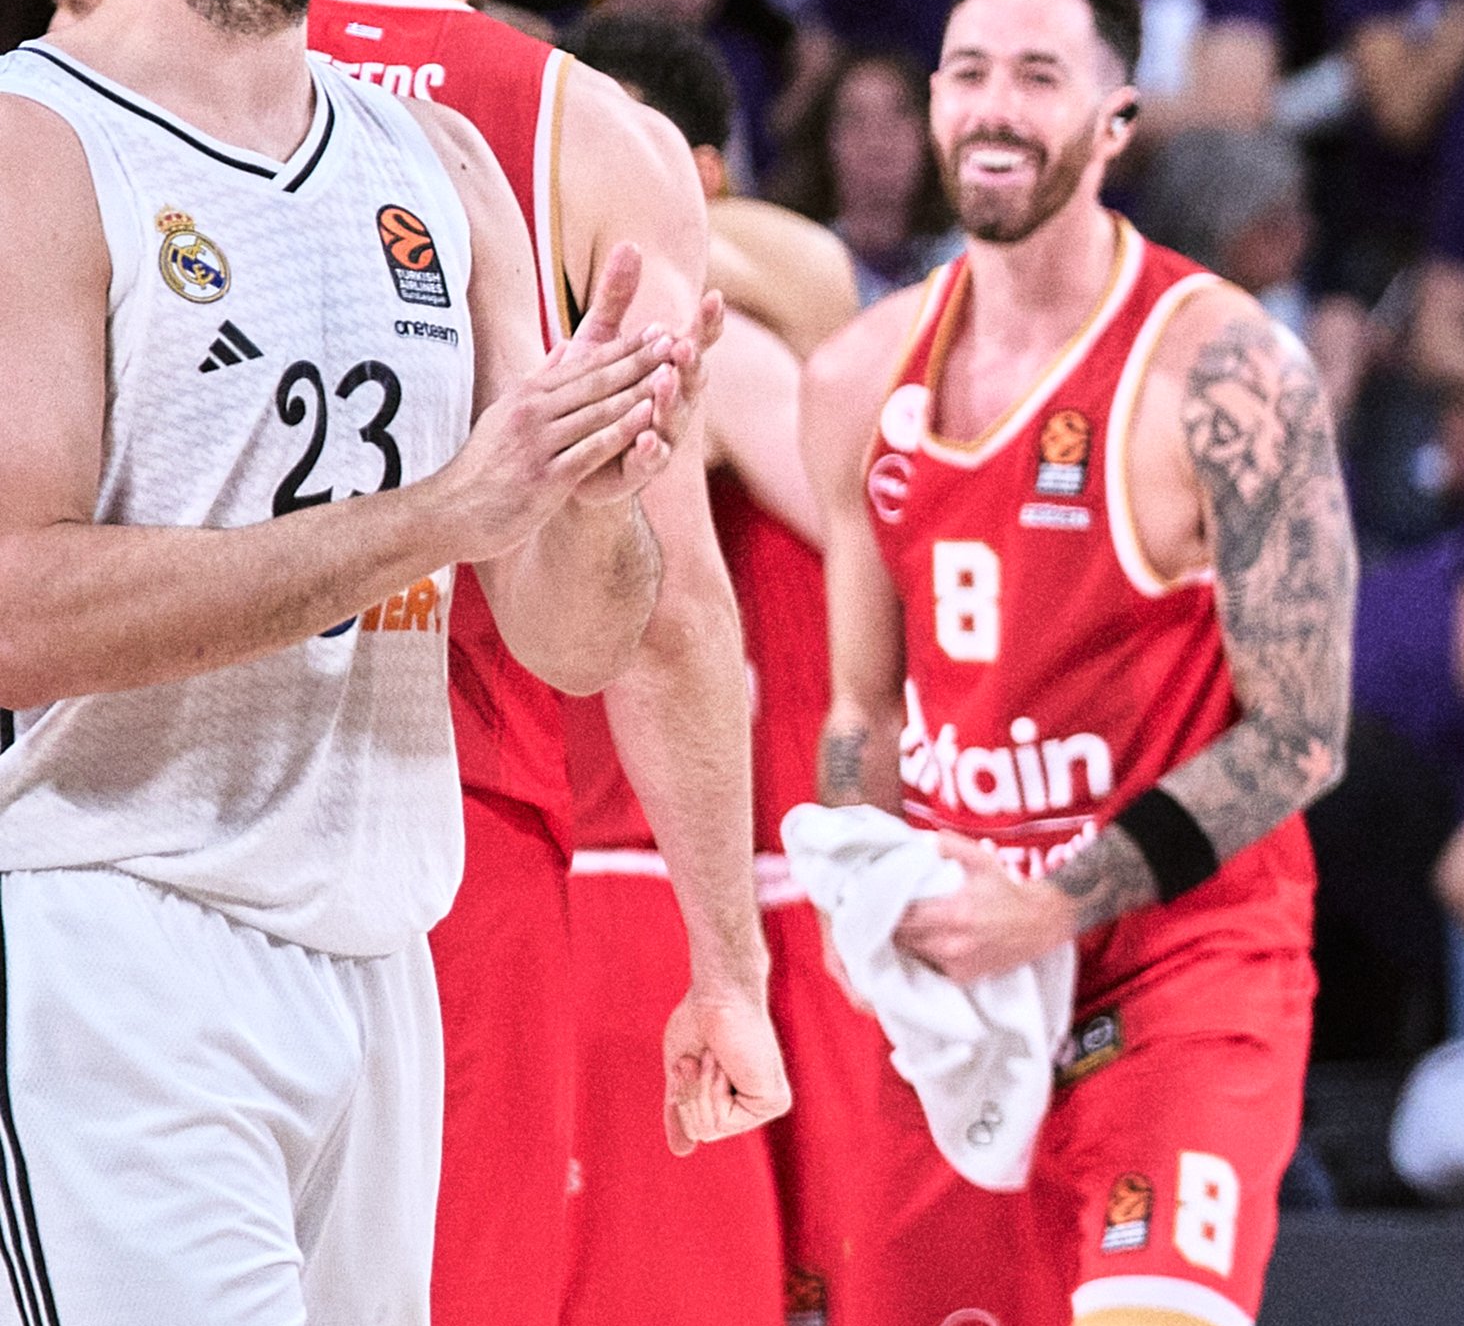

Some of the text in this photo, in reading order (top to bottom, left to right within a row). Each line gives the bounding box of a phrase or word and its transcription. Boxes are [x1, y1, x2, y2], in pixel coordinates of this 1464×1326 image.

[273, 360, 402, 519] 23
[933, 540, 1001, 663] 8
[1173, 1148, 1241, 1278] 8
